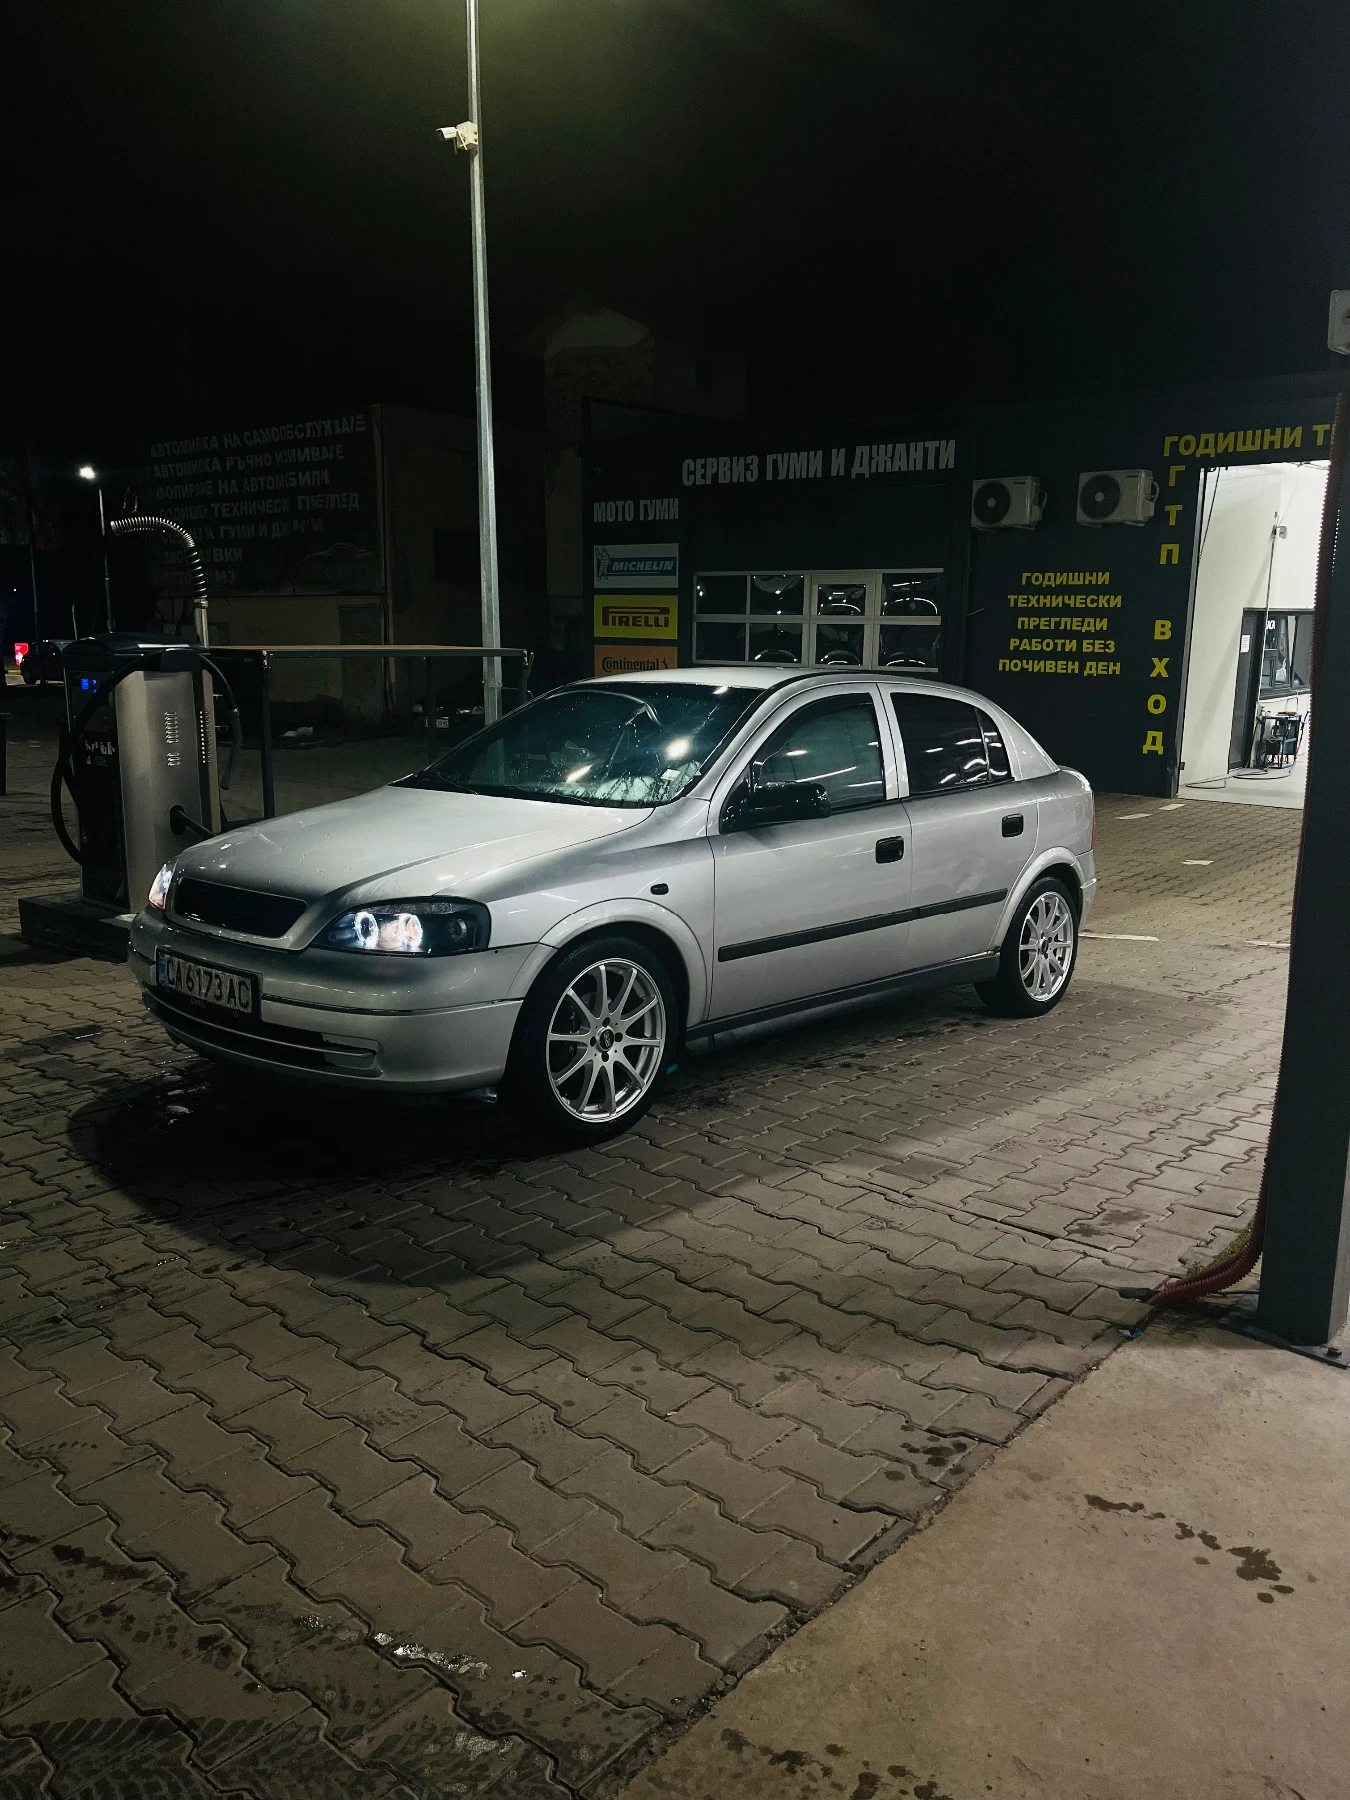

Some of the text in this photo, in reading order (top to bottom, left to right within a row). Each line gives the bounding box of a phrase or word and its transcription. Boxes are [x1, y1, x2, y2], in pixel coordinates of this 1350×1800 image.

[222, 432, 242, 449] НА
[1163, 426, 1303, 458] ГОДИШНИ
[682, 439, 956, 487] СЕРВИЗ ГУМИ И ДЖАНТИ
[218, 480, 239, 495] НА
[593, 497, 679, 523] МОТО ГУМИ
[612, 559, 675, 572] MICHELIN
[1021, 571, 1110, 587] ГОДИШНИ
[1008, 594, 1122, 609] ТЕХНИЧЕСКИ
[601, 605, 671, 629] PIRELLI
[1017, 617, 1109, 632] ПРЕГЛЕДИ
[1009, 638, 1116, 653] РАБОТИ БЕЗ
[601, 656, 661, 673] Continental
[998, 659, 1121, 677] ПОЧИВЕН ДЕН
